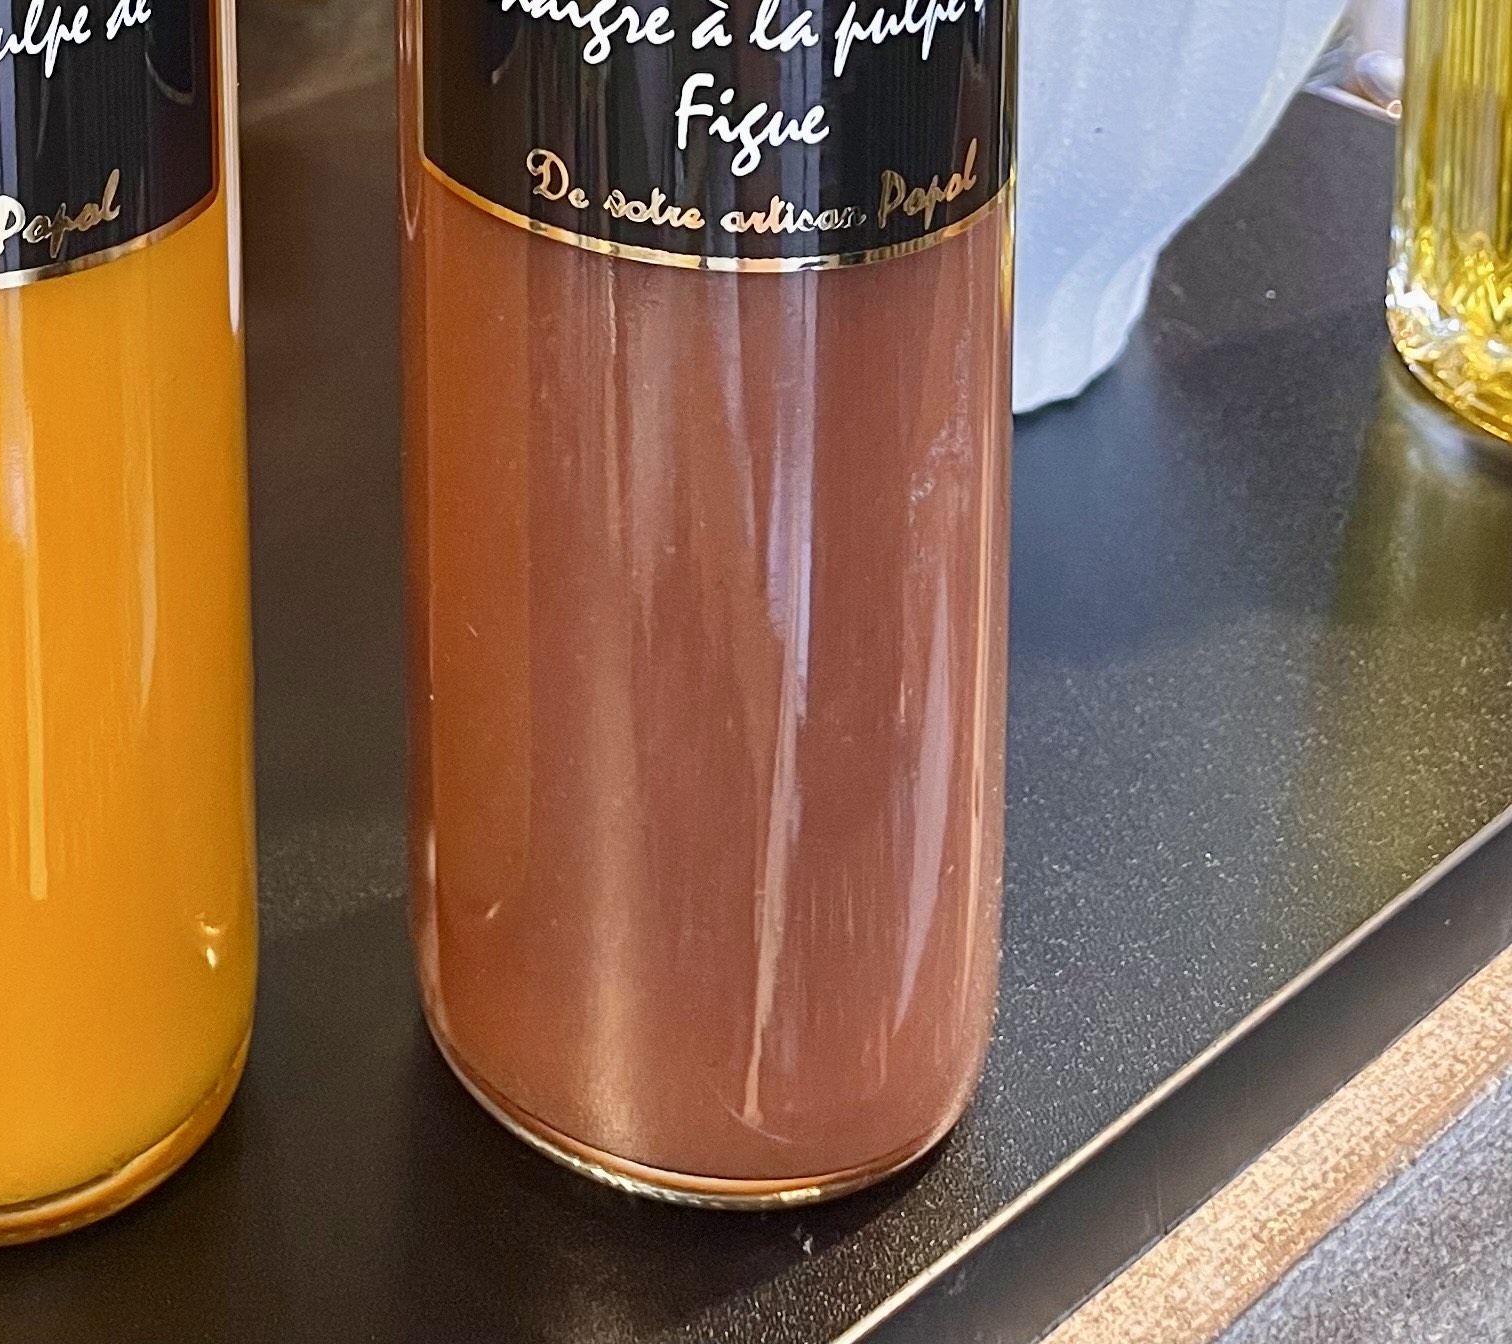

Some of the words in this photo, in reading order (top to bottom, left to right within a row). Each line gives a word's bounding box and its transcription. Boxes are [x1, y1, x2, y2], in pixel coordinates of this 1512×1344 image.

[674, 72, 830, 177] Figue
[525, 147, 590, 210] De
[719, 194, 868, 235] artisan
